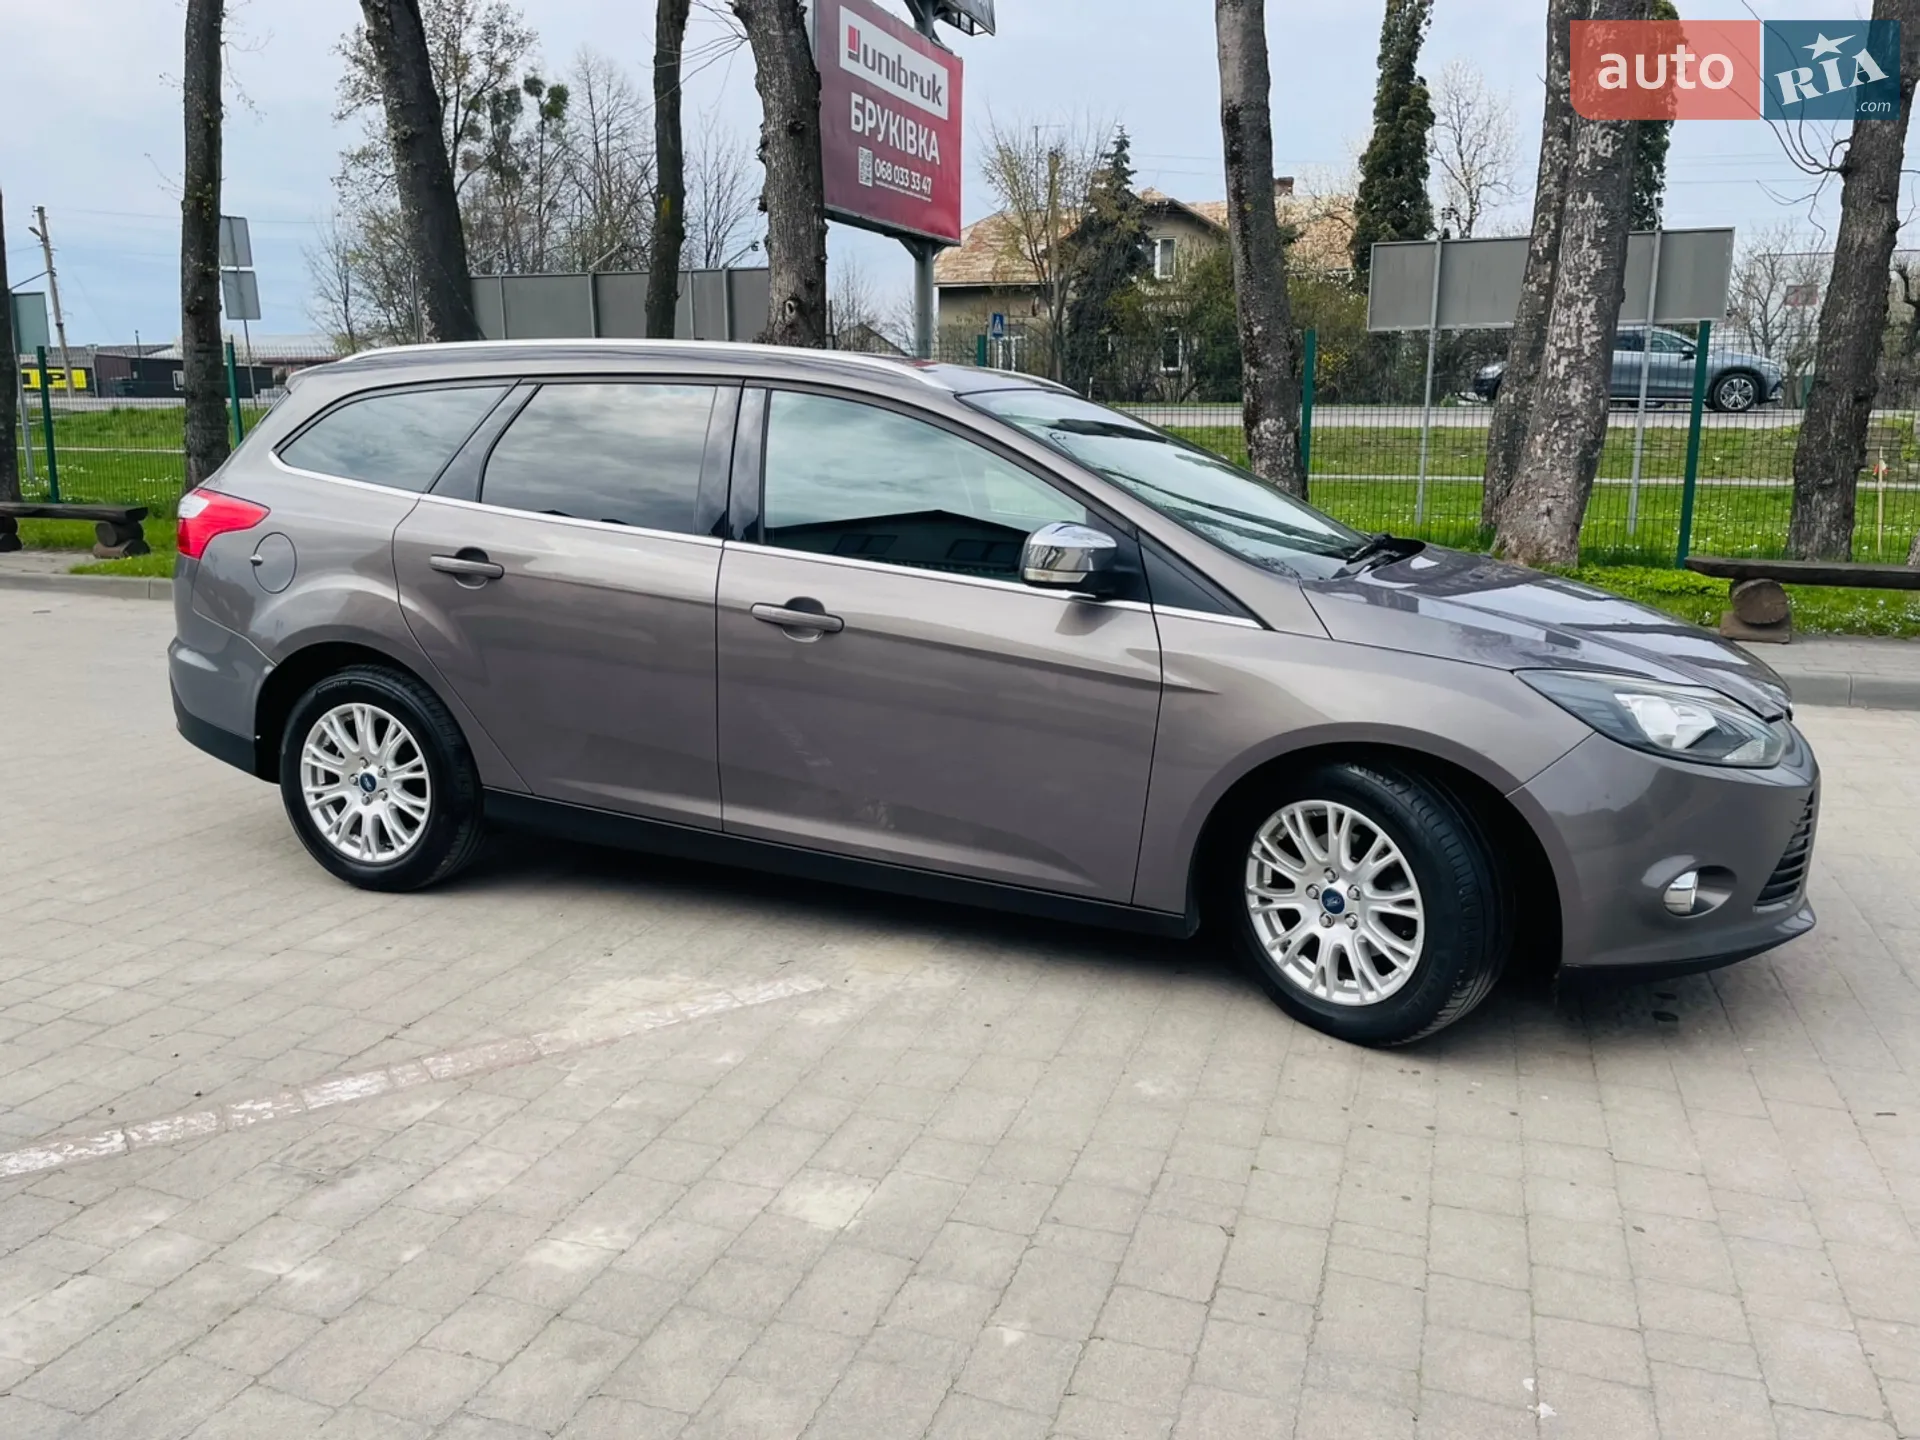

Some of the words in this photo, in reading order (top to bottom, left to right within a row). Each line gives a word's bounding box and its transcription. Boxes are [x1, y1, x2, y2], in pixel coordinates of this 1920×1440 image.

[863, 43, 942, 107] unibruk
[851, 92, 940, 165] БРУКІВКА
[874, 158, 893, 181] 068
[894, 165, 910, 187] 033
[910, 171, 921, 191] 33
[921, 176, 932, 195] 47
